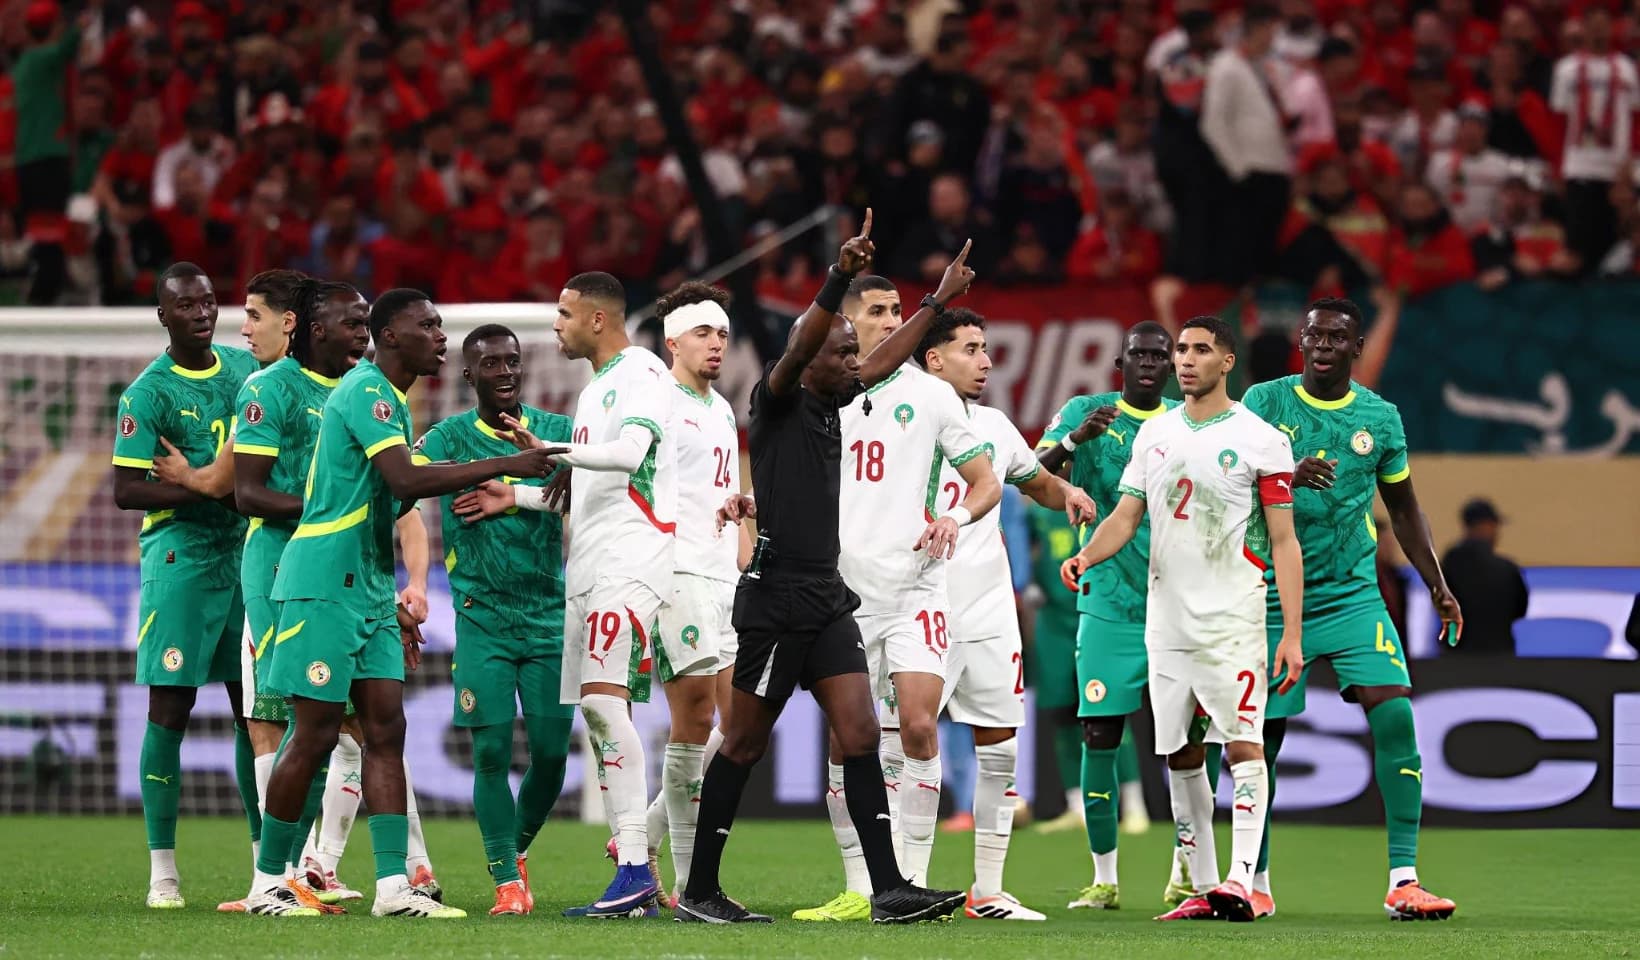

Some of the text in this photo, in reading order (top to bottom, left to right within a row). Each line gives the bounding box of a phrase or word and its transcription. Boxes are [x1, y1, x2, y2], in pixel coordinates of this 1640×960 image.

[211, 415, 237, 459] 2
[714, 446, 731, 488] 24
[850, 440, 885, 482] 18
[1174, 478, 1193, 520] 2
[586, 611, 620, 651] 19
[915, 609, 948, 650] 18
[1376, 622, 1397, 655] 4
[1237, 670, 1257, 711] 2
[1165, 687, 1640, 812] SC
